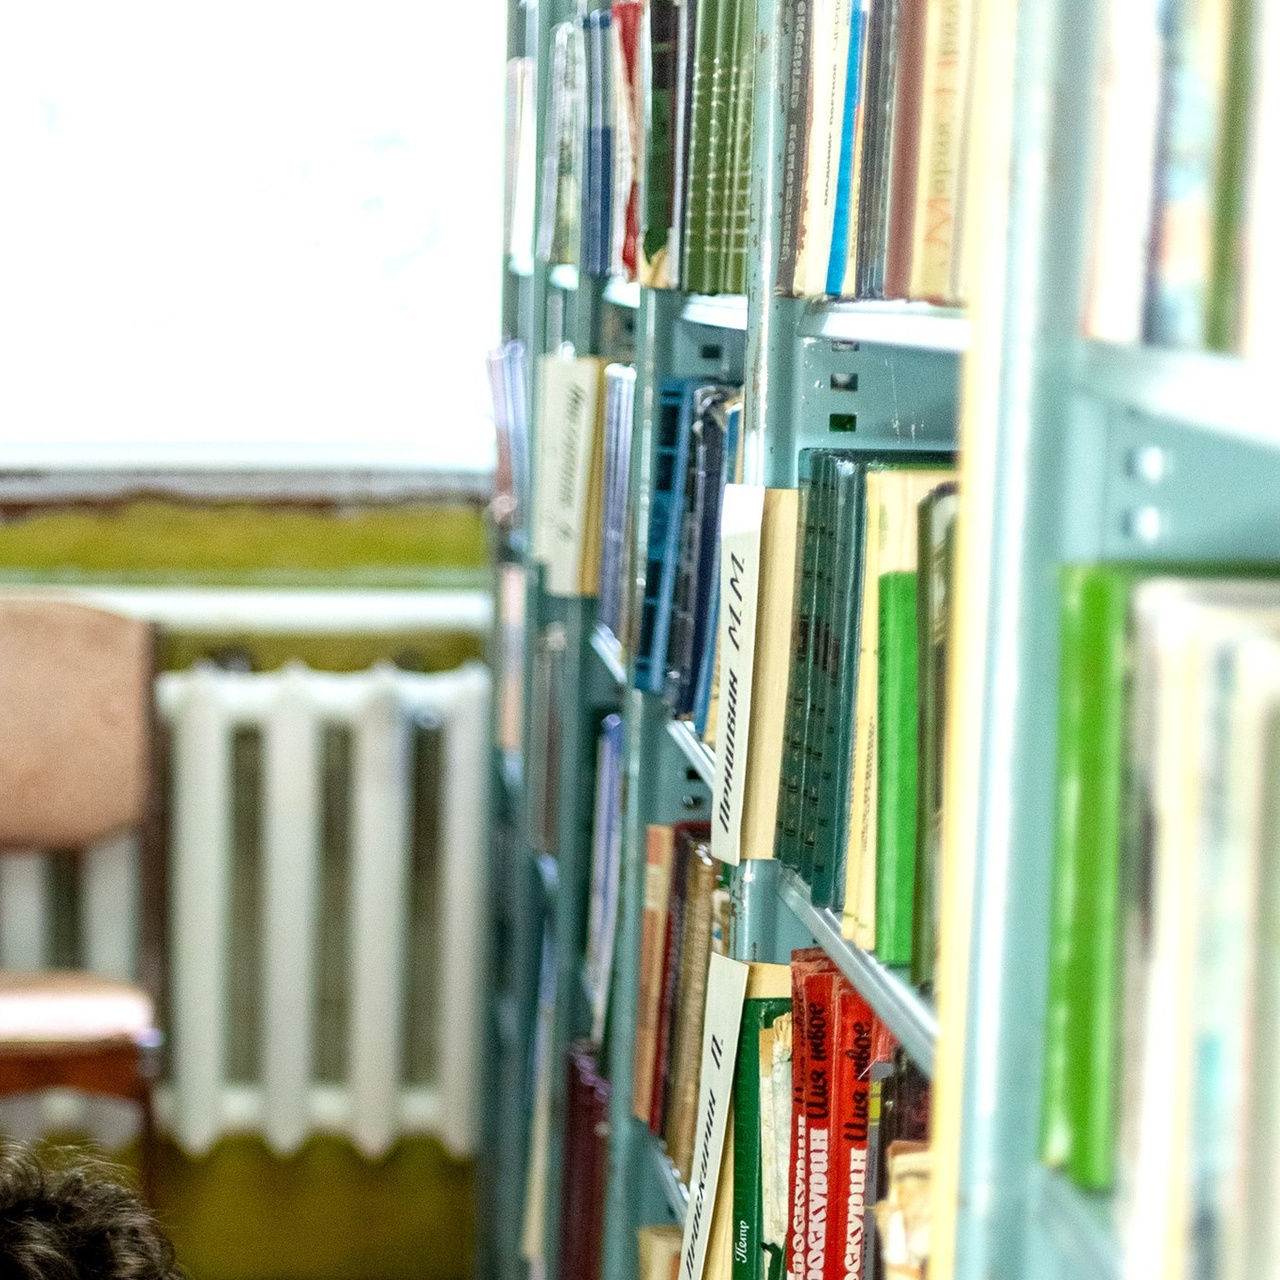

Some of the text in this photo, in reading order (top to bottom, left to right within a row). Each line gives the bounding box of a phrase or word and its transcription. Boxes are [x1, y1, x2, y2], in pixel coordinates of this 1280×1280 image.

[719, 669, 740, 834] Пришвин
[805, 1002, 828, 1062] твое
[848, 1021, 872, 1082] твое
[805, 1069, 829, 1120] Имя
[845, 1087, 869, 1141] Имя
[683, 1034, 725, 1280] Проскурин П.
[734, 1219, 750, 1264] Петр
